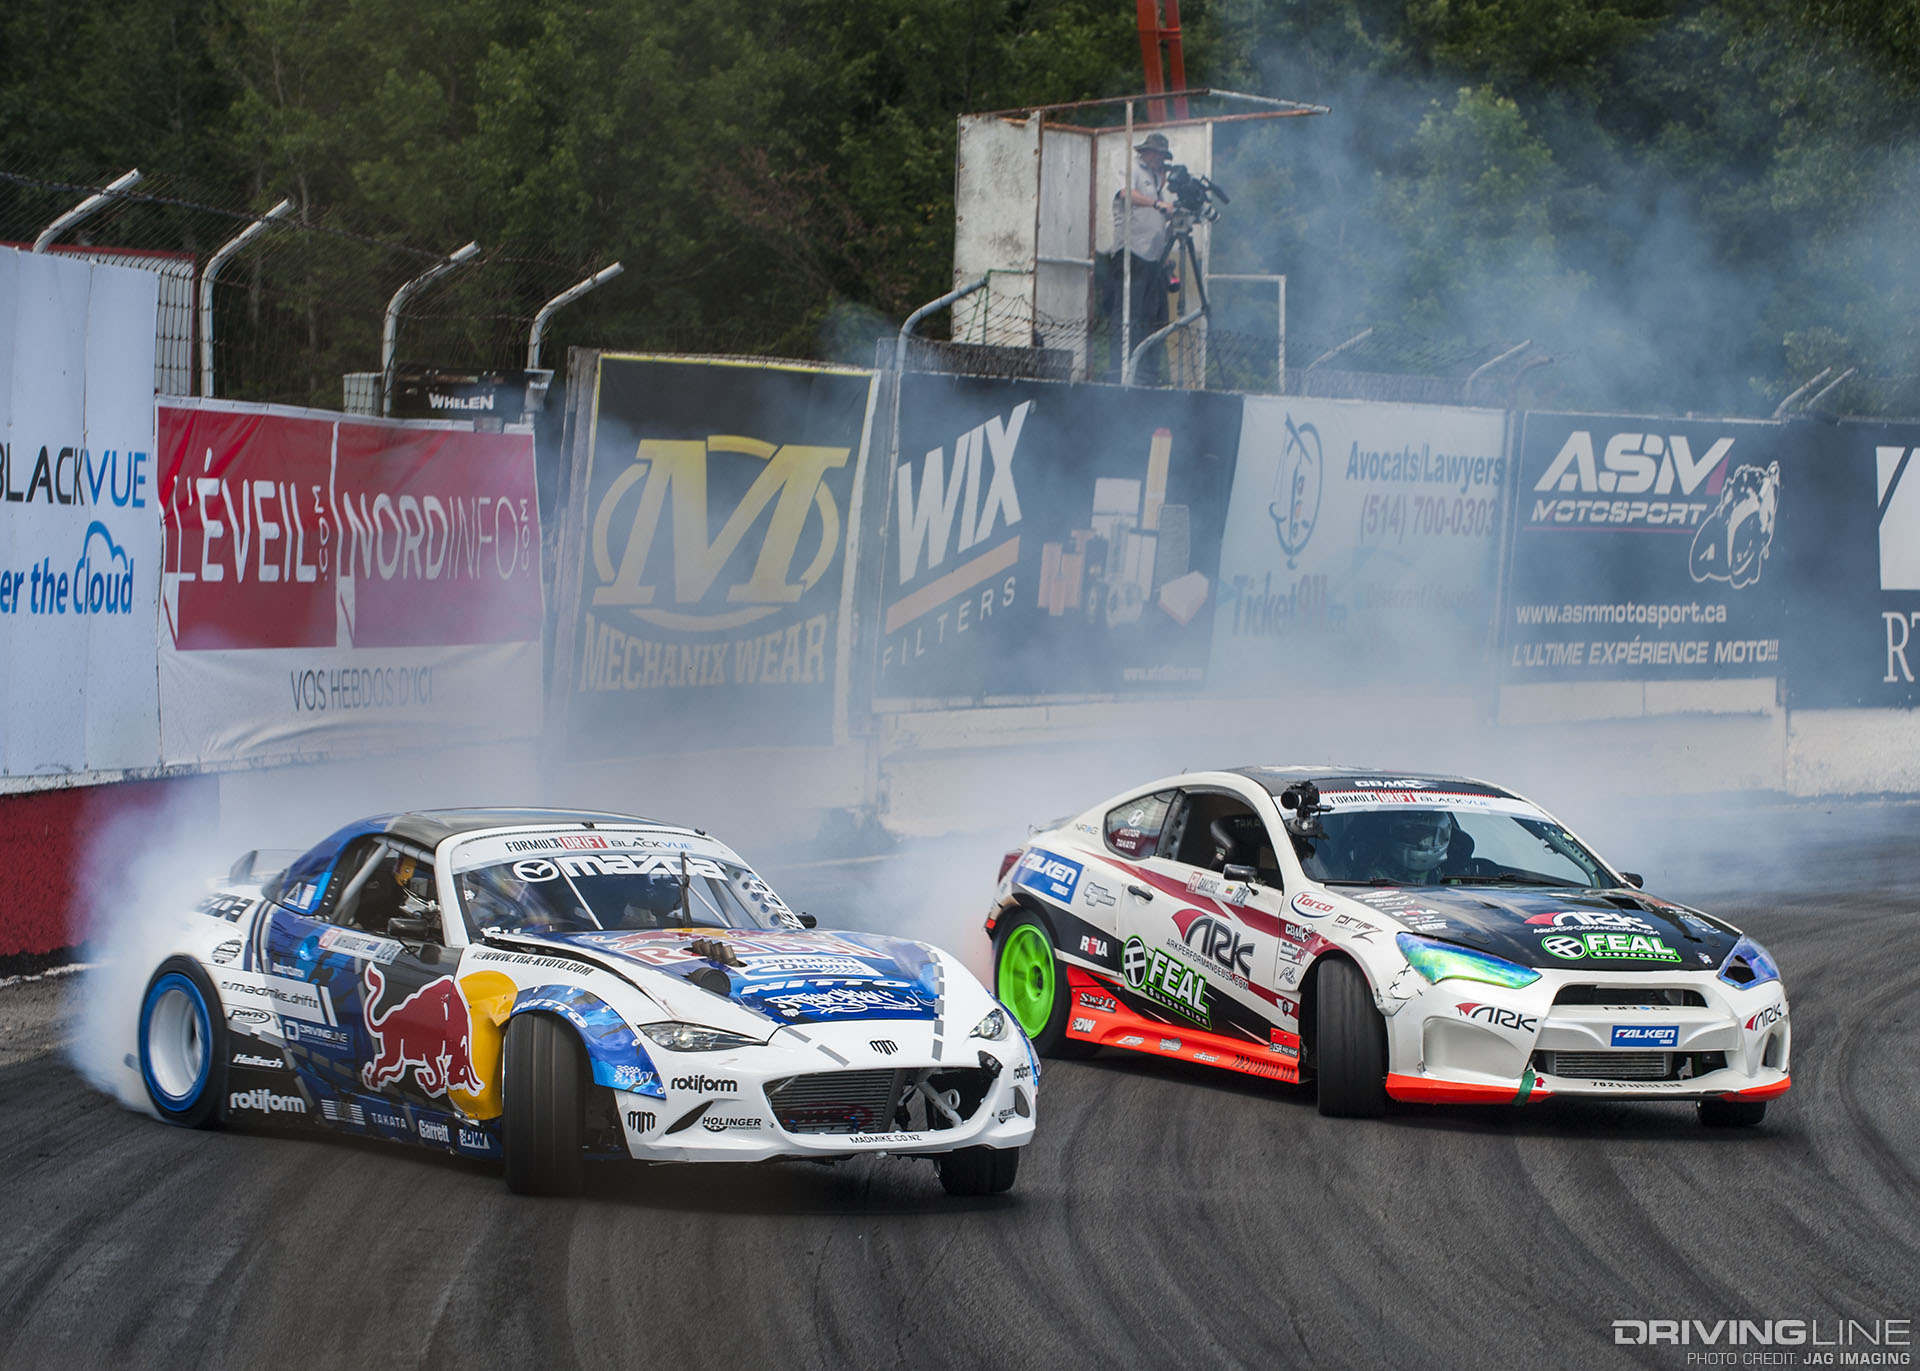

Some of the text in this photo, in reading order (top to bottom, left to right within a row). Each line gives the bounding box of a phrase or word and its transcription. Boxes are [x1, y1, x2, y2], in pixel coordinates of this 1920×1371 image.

[429, 392, 494, 410] WHELEN
[1345, 440, 1506, 494] Avocats/Lawyers
[1534, 431, 1735, 496] ASM
[898, 400, 1032, 583] WIX
[1360, 493, 1497, 544] (514) 700-0303
[1531, 500, 1707, 525] MOTOSPORT
[343, 491, 519, 580] NORDINFO
[0, 556, 134, 615] er the Cloud
[881, 576, 1018, 671] FILTERS
[1516, 601, 1728, 629] www.asmmotosport.ca
[578, 611, 827, 693] MECHANIX WEAR
[1512, 633, 1779, 667] L'ULTIME EXPÉRIENCE MOTO!!!
[290, 668, 326, 712] VOS
[330, 667, 394, 710] HEBDOS
[1330, 792, 1378, 804] FORMULA
[505, 836, 694, 852] FORMULA DRIFT BLACKVUE
[555, 855, 729, 881] mazda
[1021, 853, 1078, 886] FALKEN
[1297, 893, 1334, 912] Torco
[1172, 910, 1256, 979] ARK
[1585, 935, 1674, 954] FEAL
[1595, 951, 1676, 960] Suspension
[480, 951, 595, 976] WWW.TRA-KYOTO.COM
[1166, 938, 1249, 992] ARKPERFORMANCEUSA.COM
[740, 979, 911, 995] NITTO
[1148, 952, 1208, 1015] FEAL
[1080, 992, 1117, 1009] Swift
[1148, 987, 1208, 1026] Suspension
[1457, 1002, 1538, 1033] ARK
[1745, 1002, 1782, 1032] ARK
[1615, 1029, 1675, 1039] FALKEN
[232, 1053, 284, 1068] Haltech
[671, 1074, 738, 1094] rotiform
[230, 1089, 307, 1114] rotiform
[371, 1112, 408, 1129] TAKATA
[418, 1119, 450, 1142] Garrett
[702, 1116, 762, 1127] HOLINGER
[849, 1134, 922, 1144] MADMIKE.CO.NZ
